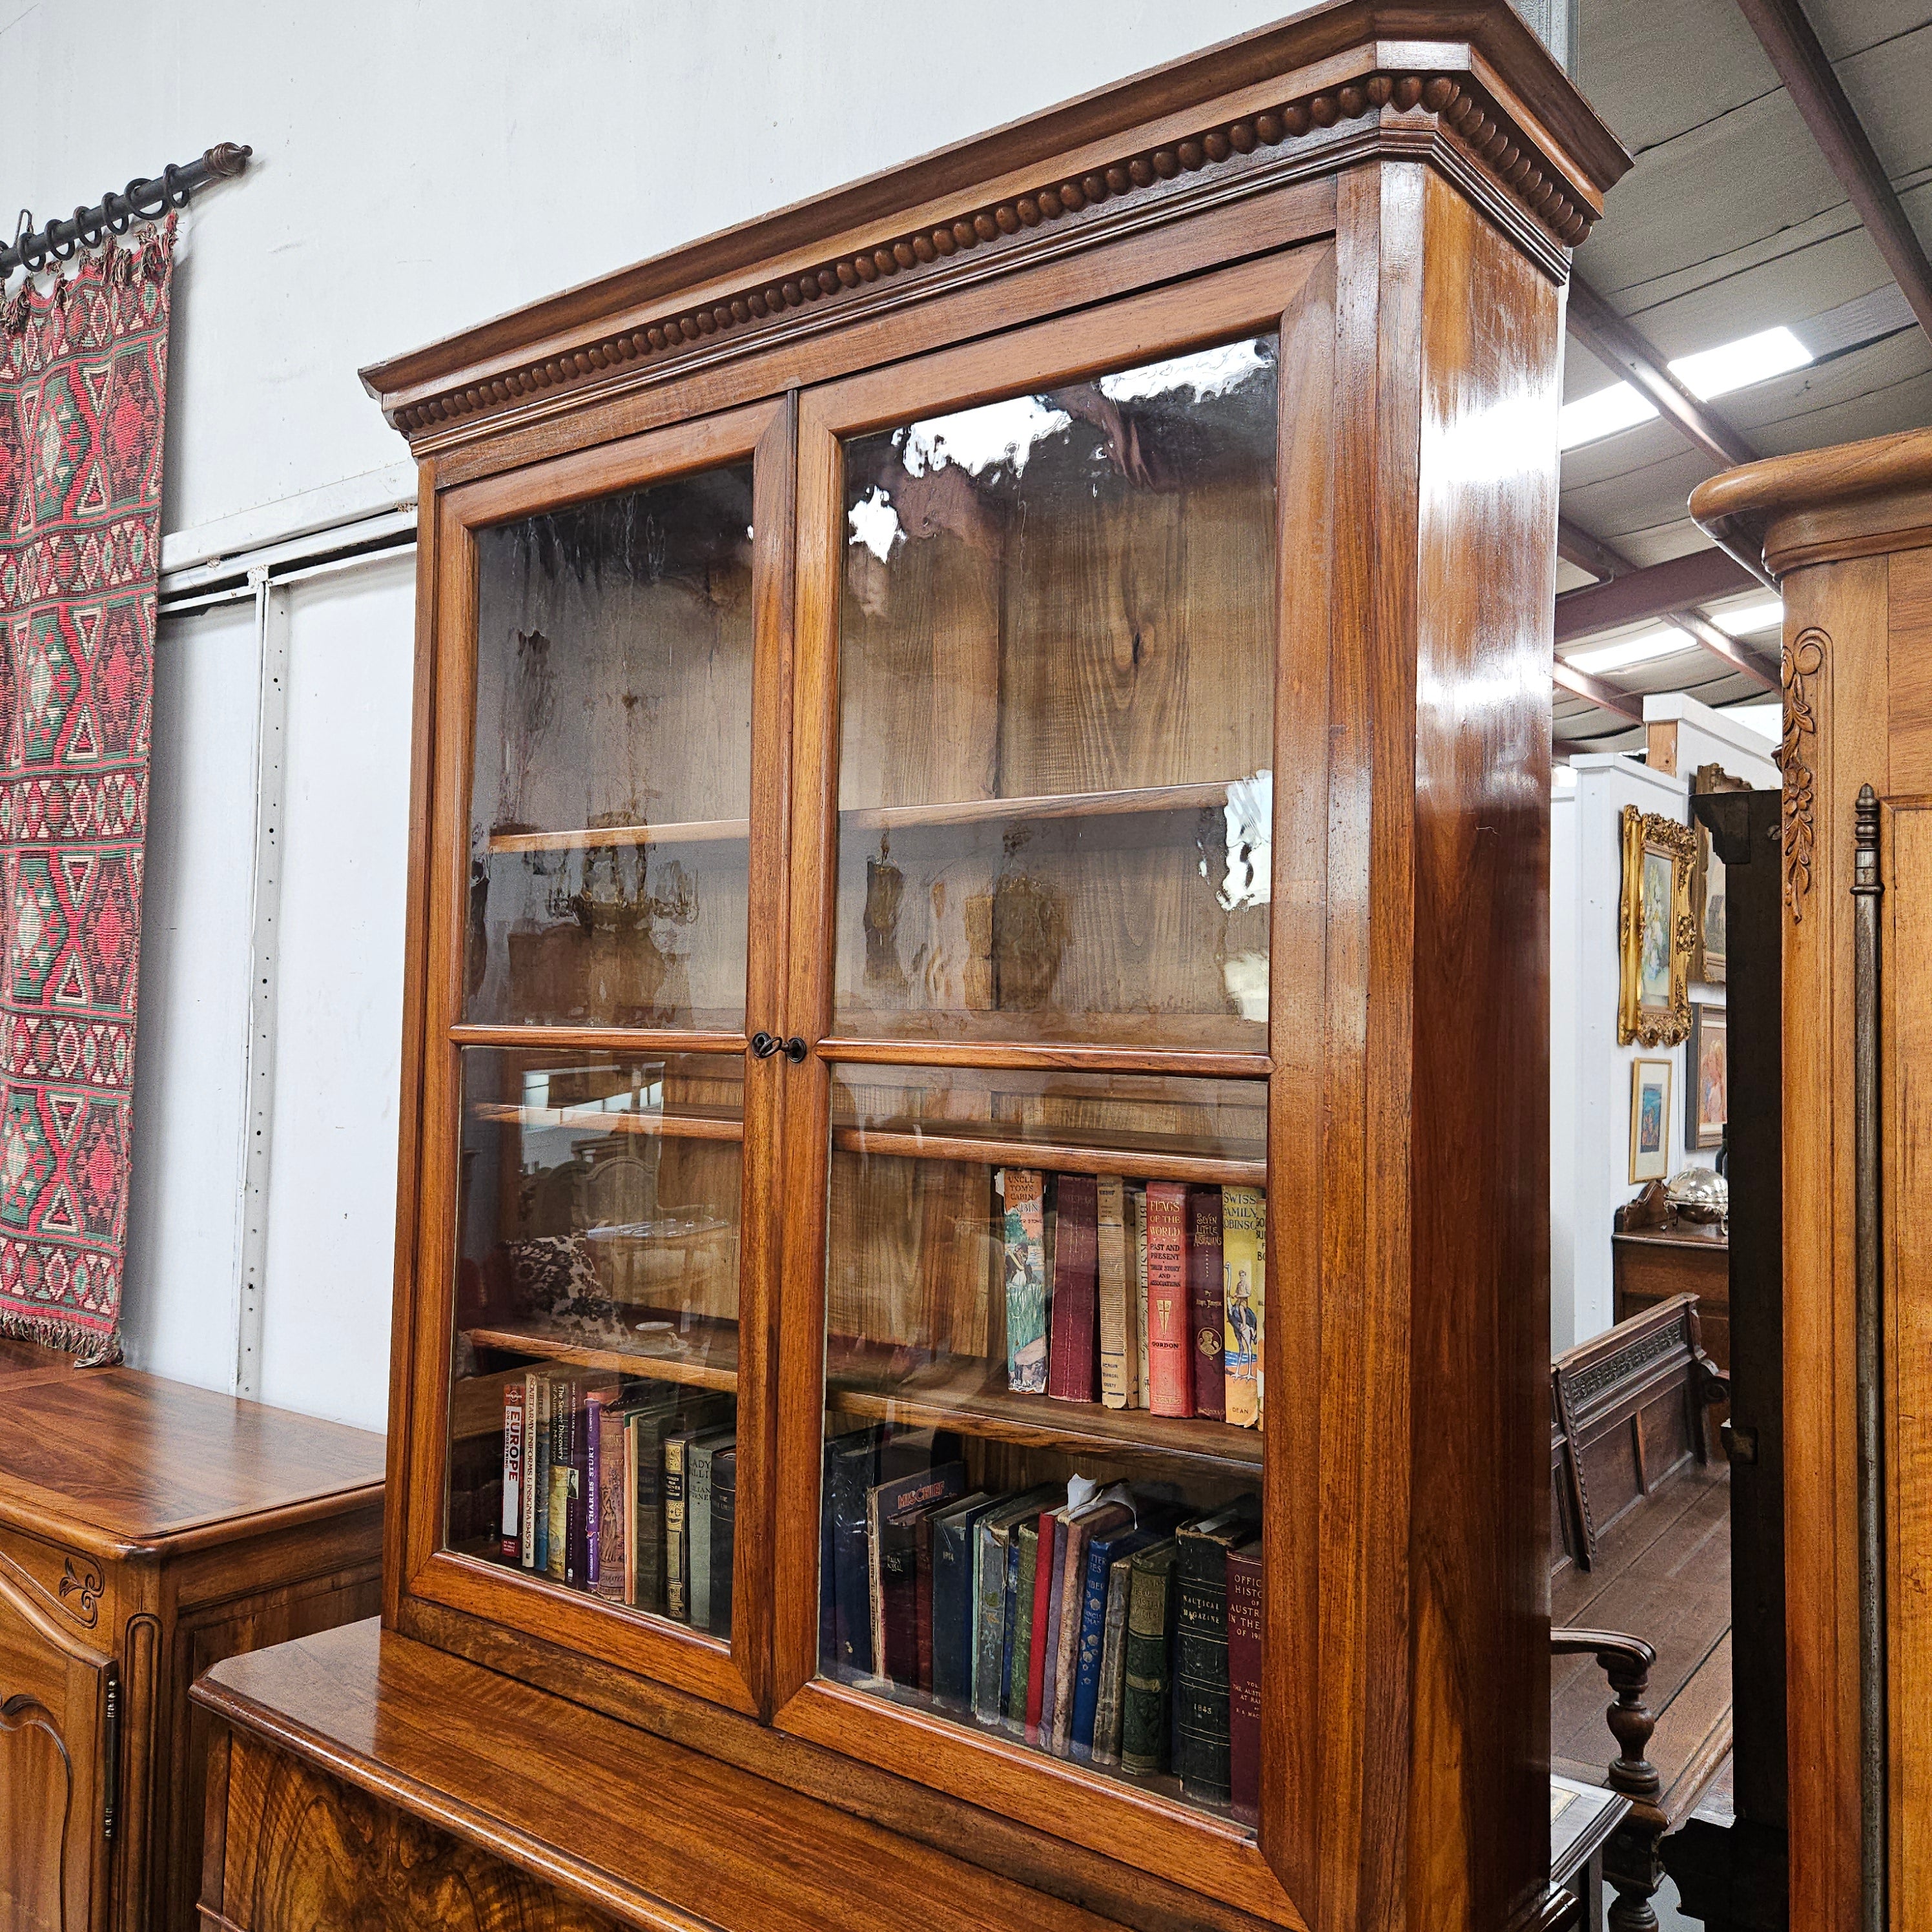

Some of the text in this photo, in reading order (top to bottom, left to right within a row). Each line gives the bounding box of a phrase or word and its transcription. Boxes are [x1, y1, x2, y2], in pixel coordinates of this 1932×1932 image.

[1224, 1191, 1256, 1204] SWISS
[1150, 1201, 1180, 1212] FLAGS
[1162, 1215, 1181, 1224] THE
[1149, 1226, 1180, 1237] WORLD
[506, 1410, 511, 1420] ON
[509, 1411, 520, 1482] EUROPE
[898, 1480, 945, 1510] MISCHIEF
[1183, 1594, 1219, 1610] NAUTICAL
[1183, 1608, 1220, 1624] MAGAZINE
[1228, 1613, 1260, 1630] IN THE
[1236, 1628, 1246, 1636] OF
[1233, 1683, 1242, 1692] THE
